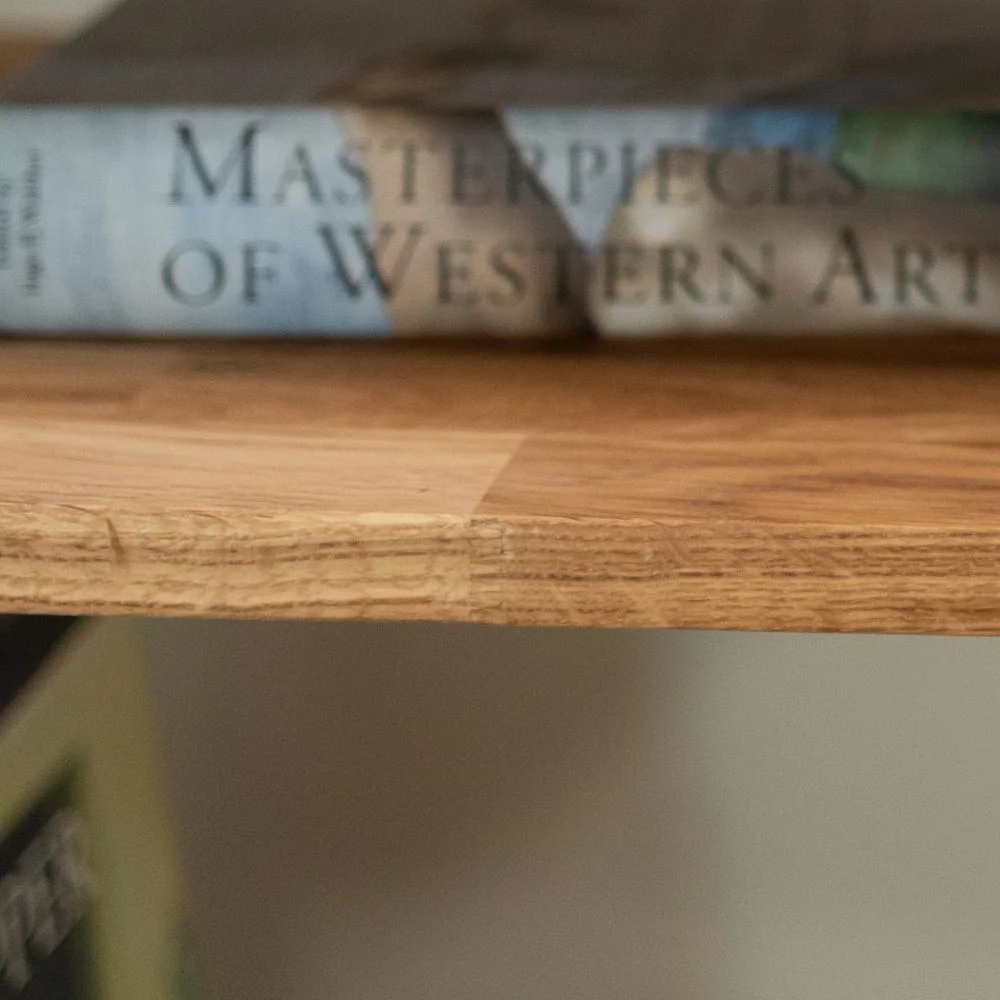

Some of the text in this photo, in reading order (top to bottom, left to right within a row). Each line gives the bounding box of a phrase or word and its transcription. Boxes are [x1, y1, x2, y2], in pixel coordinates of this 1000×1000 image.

[167, 117, 869, 207] MASTERPIECES
[160, 220, 996, 310] OF WESTERN ART
